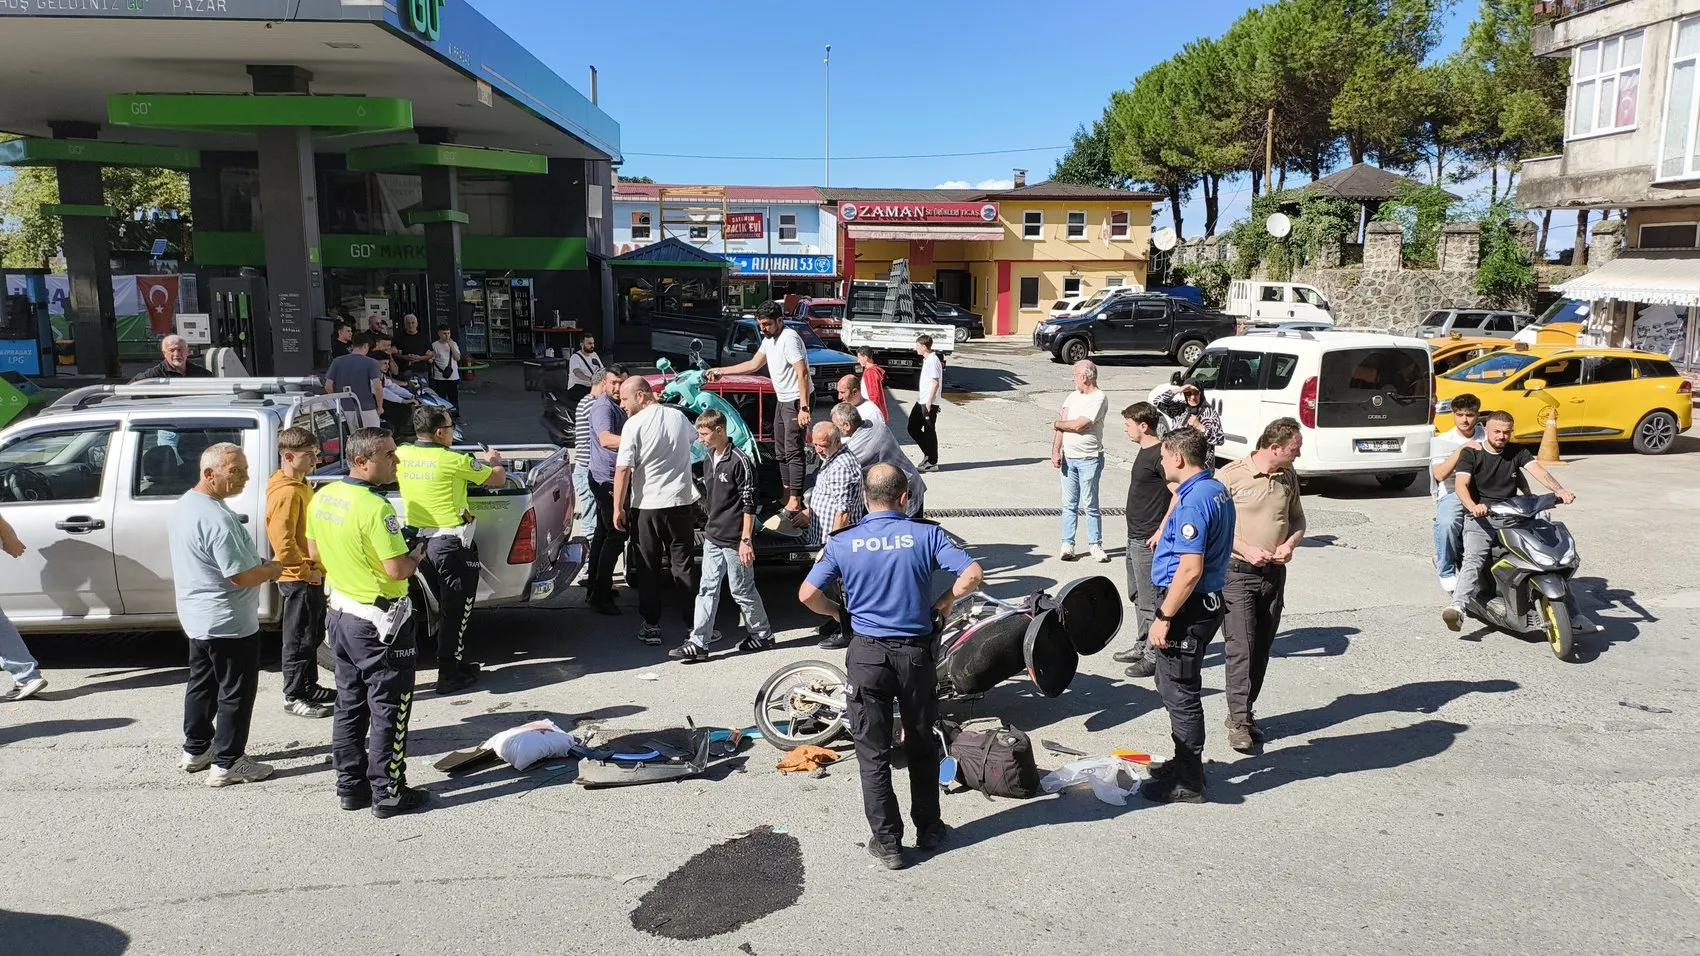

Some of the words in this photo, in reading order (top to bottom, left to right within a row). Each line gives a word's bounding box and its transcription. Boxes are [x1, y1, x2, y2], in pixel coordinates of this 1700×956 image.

[172, 0, 226, 12] PAZAR
[859, 205, 925, 218] ZAMAN
[350, 243, 371, 258] GO
[800, 257, 813, 271] 53
[8, 355, 25, 364] LPG
